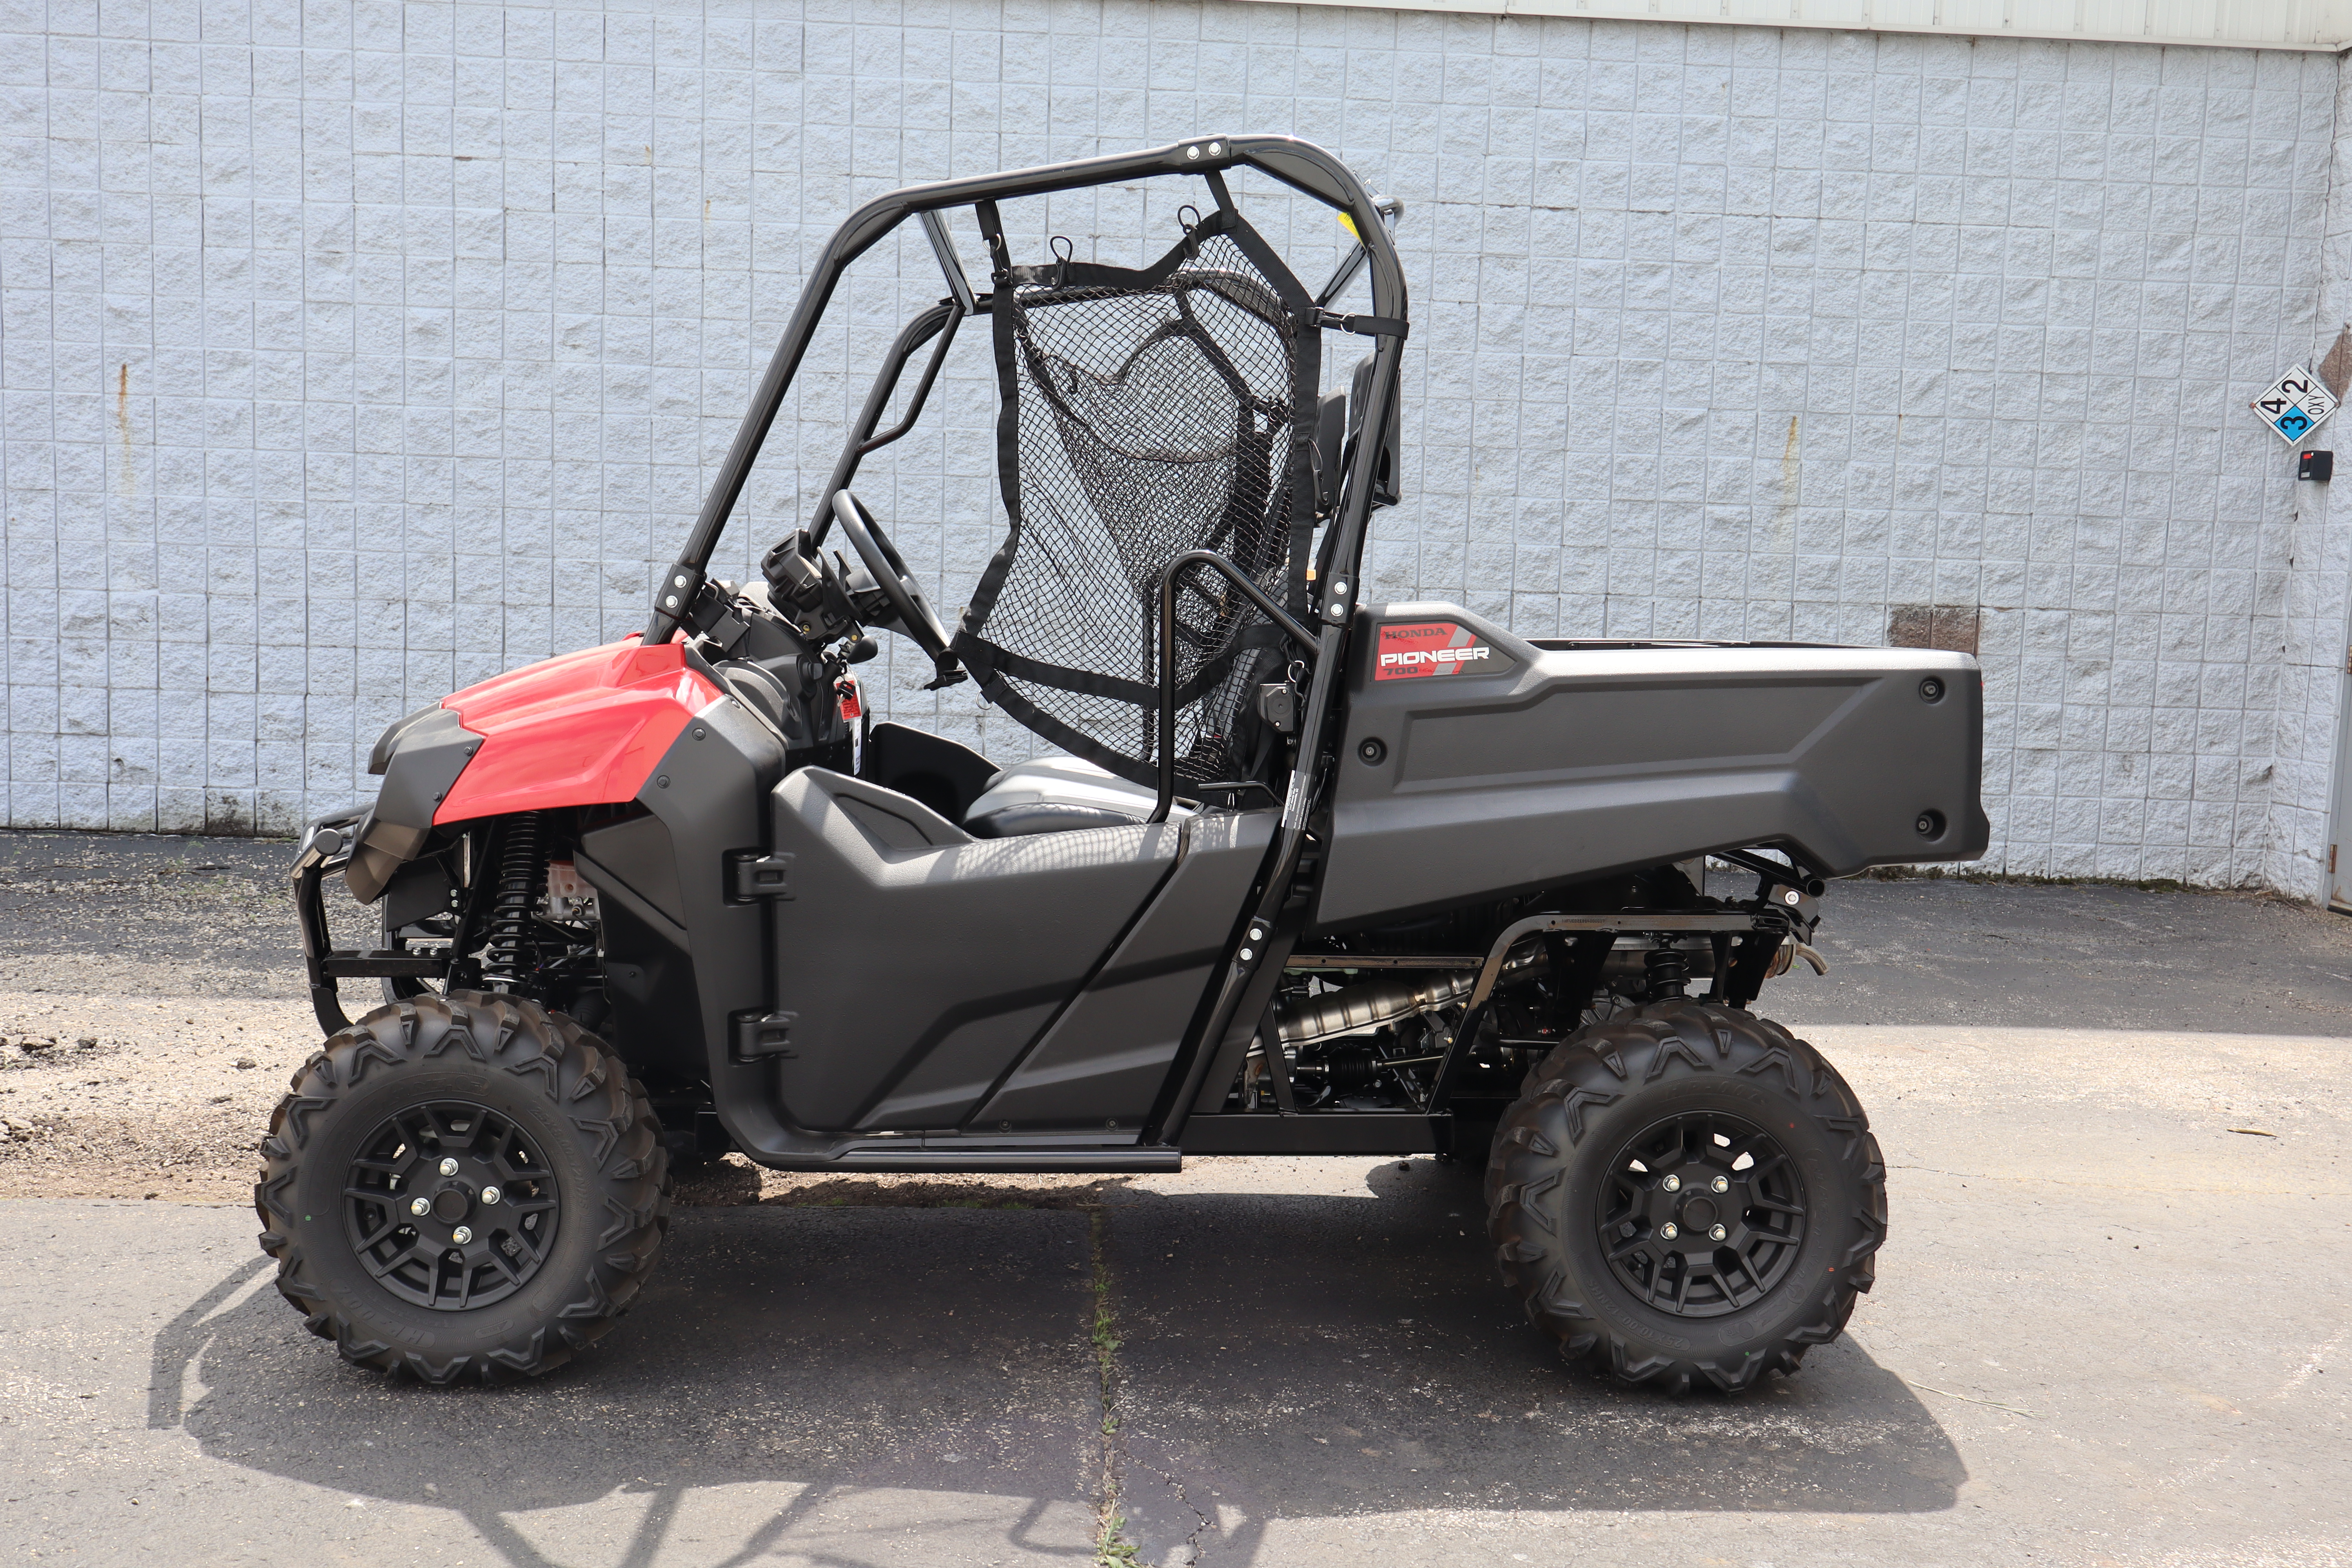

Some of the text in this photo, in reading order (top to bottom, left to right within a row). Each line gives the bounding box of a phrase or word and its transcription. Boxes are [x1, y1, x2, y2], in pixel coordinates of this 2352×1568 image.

[2281, 379, 2308, 394] 2
[2260, 398, 2287, 414] 4
[2307, 395, 2325, 415] OXY
[2280, 416, 2307, 430] 3
[1385, 628, 1448, 640] HONDA
[1380, 646, 1489, 666] PIONEER
[1383, 666, 1418, 676] 700
